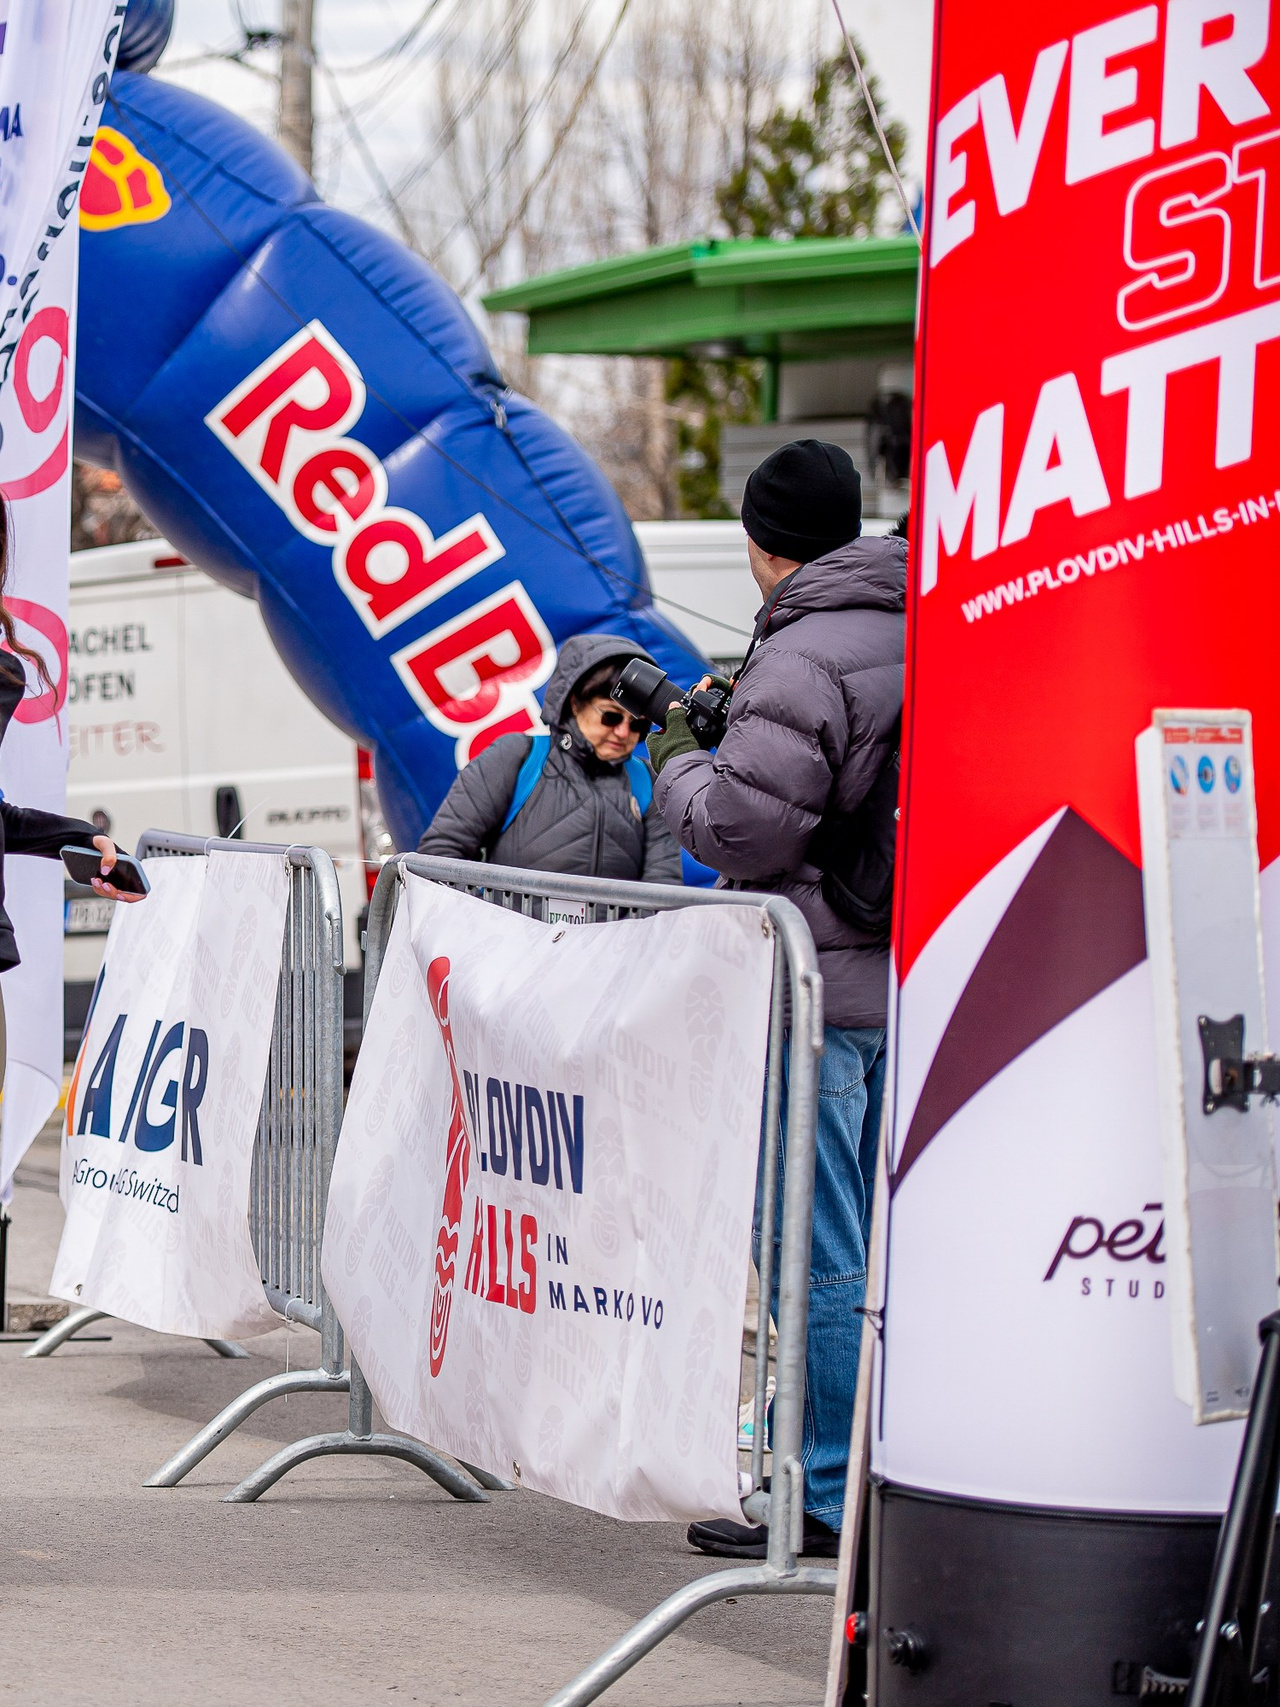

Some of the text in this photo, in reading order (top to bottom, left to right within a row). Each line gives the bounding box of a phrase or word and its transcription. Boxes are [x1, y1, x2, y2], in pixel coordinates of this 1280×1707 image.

[204, 319, 506, 640] Red
[547, 1232, 569, 1266] IN
[548, 1280, 664, 1330] MARKOVO
[1081, 1276, 1166, 1299] STUD
